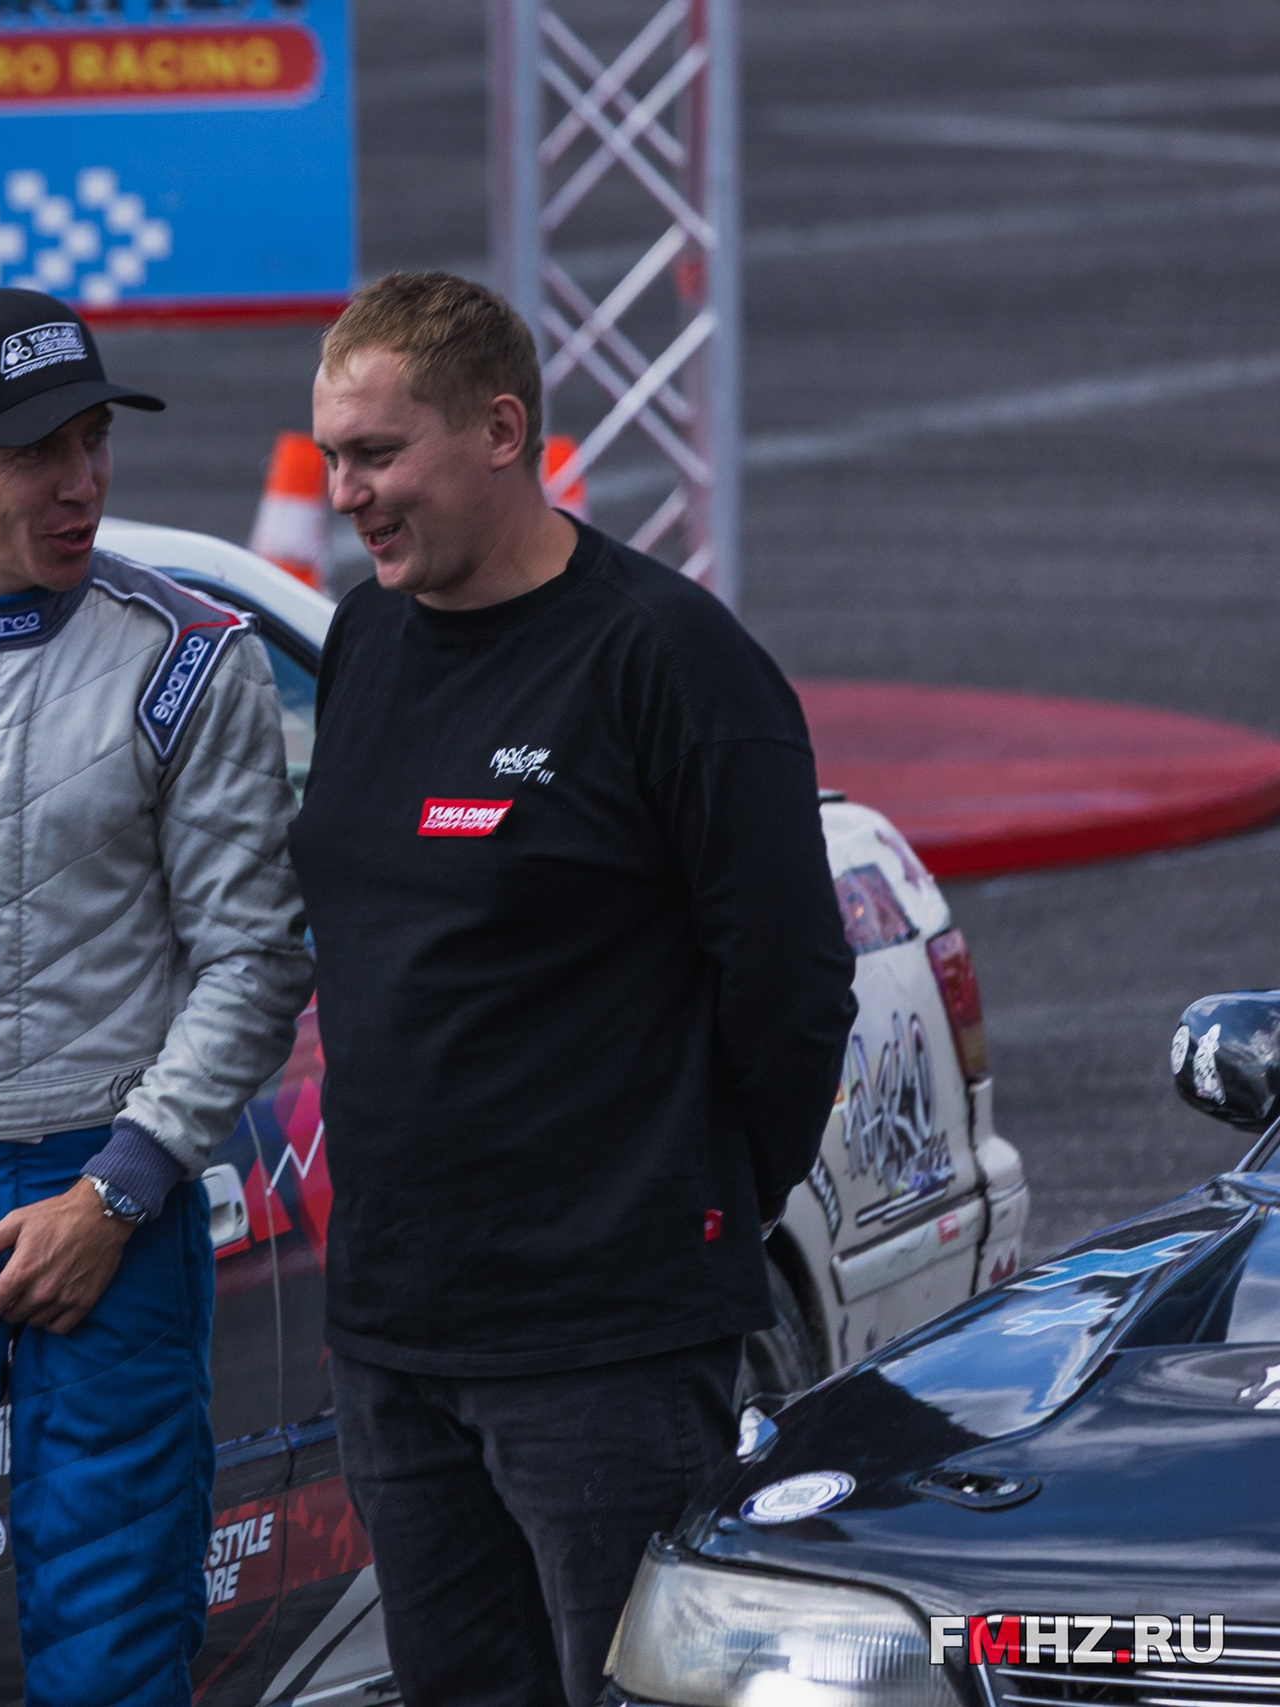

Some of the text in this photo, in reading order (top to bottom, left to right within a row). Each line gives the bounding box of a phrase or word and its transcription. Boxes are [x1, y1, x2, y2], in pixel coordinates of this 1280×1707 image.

[68, 36, 283, 93] RACING
[152, 636, 211, 725] sparco
[428, 806, 465, 820] YUKA
[204, 1511, 275, 1568] STYLE
